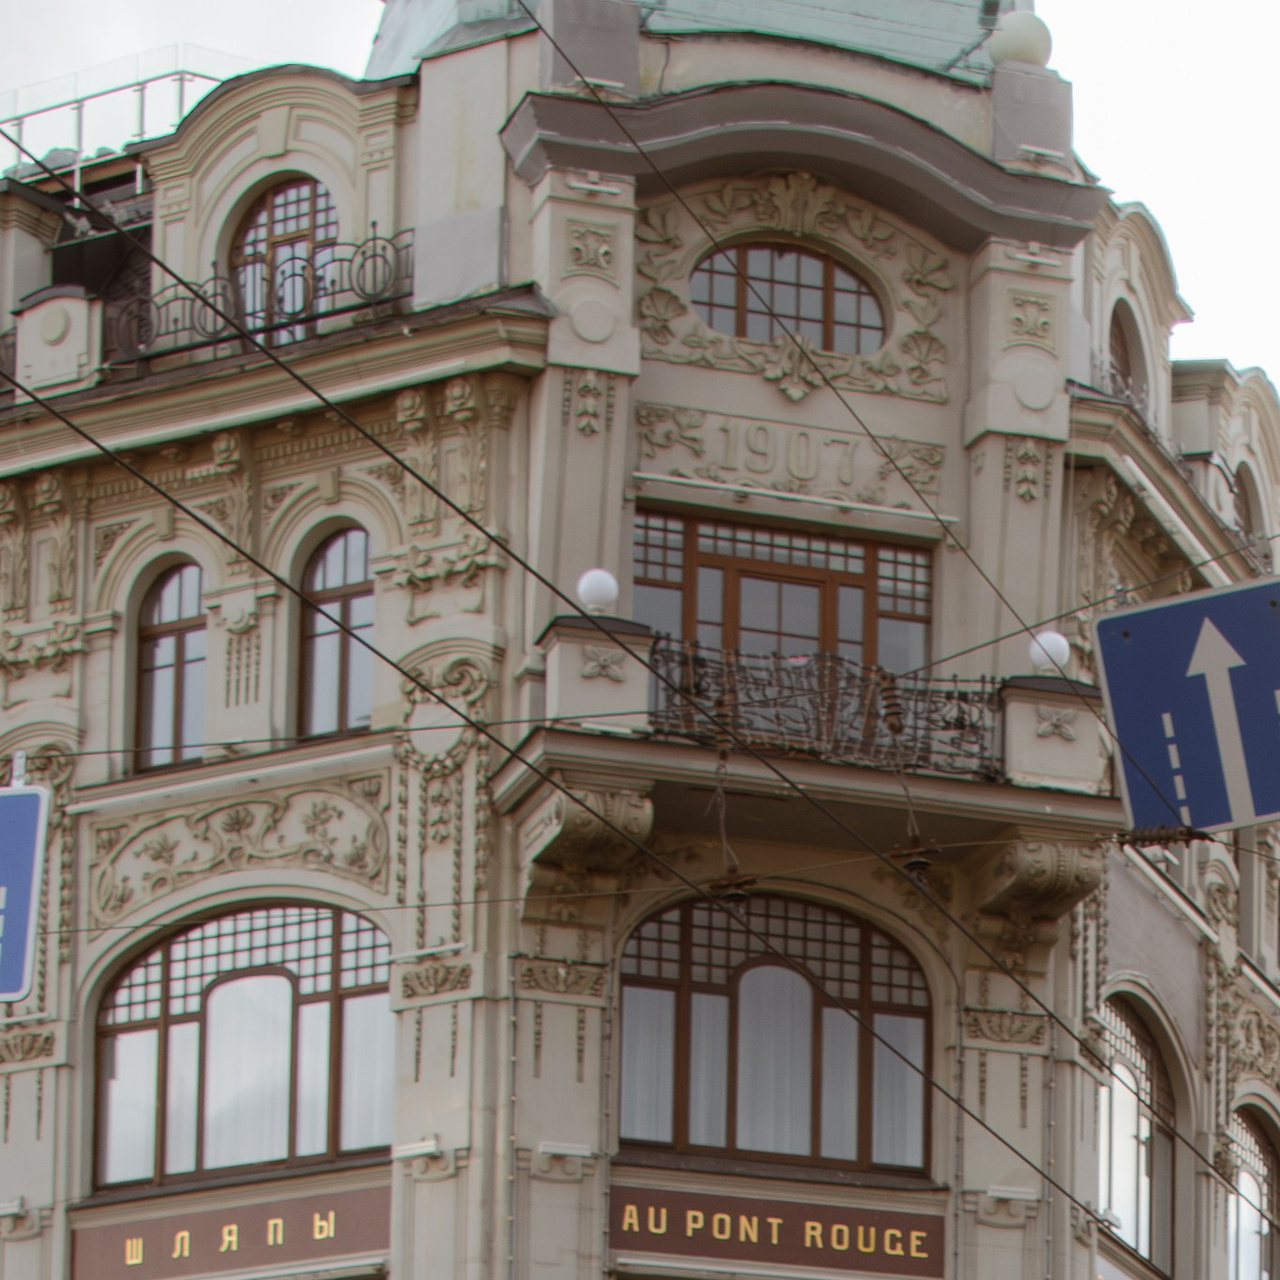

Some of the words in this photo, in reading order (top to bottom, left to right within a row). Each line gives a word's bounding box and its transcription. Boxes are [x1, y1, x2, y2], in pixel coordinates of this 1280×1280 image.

[718, 421, 860, 486] 1907
[124, 1210, 336, 1266] ШЛЯПЫ
[620, 1203, 668, 1236] AU
[684, 1211, 784, 1246] PONT
[803, 1220, 930, 1260] ROUGE
